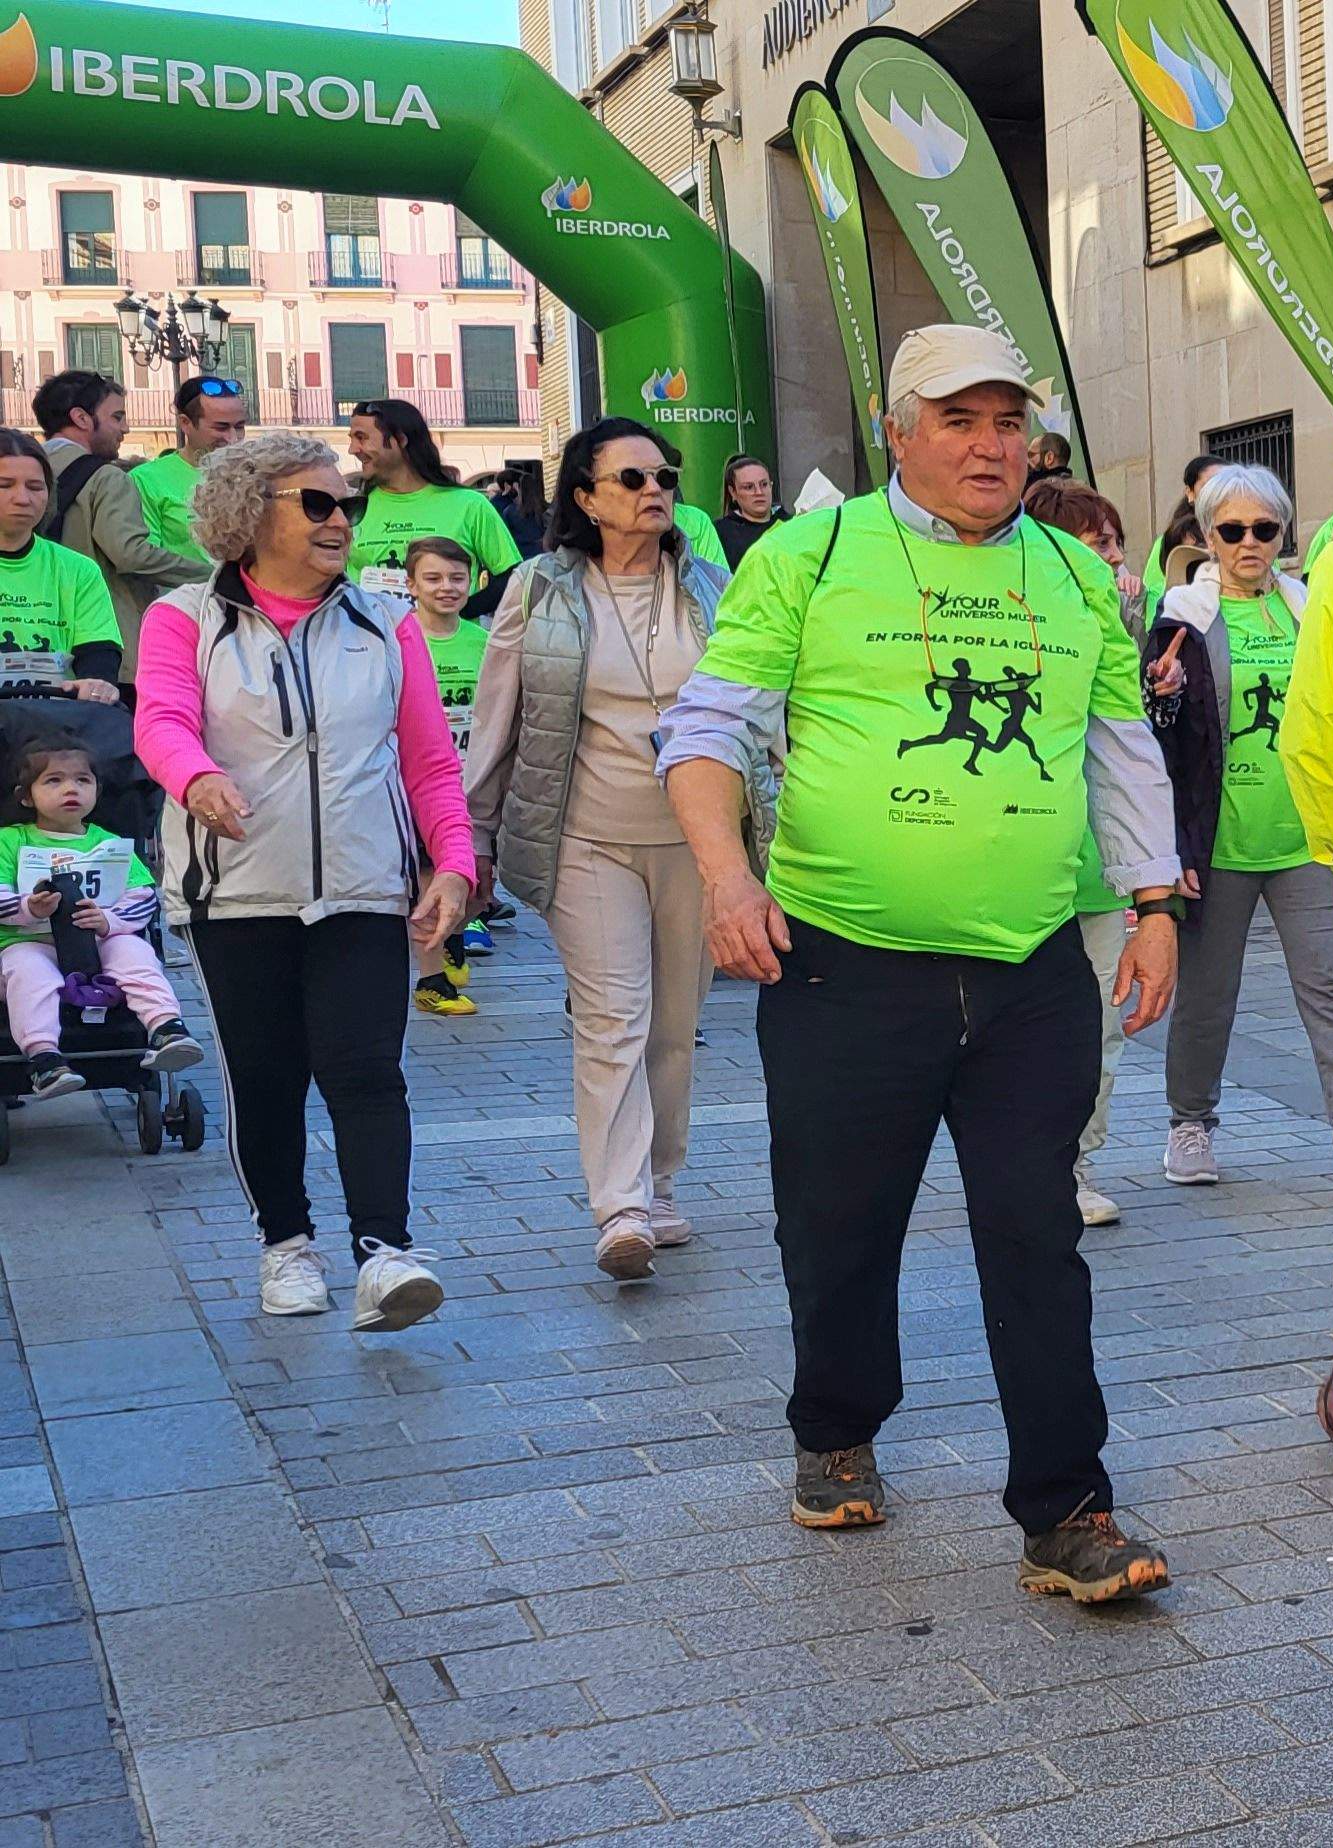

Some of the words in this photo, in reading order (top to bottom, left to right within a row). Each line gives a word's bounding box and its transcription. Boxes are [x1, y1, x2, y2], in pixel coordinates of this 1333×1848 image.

[50, 46, 441, 130] IBERDROLA
[555, 218, 671, 240] IBERDROLA
[654, 407, 756, 425] IBERDROA
[940, 609, 1005, 620] UNIVERSO
[866, 632, 888, 643] EN
[953, 633, 985, 647] POR
[990, 638, 1010, 650] LA
